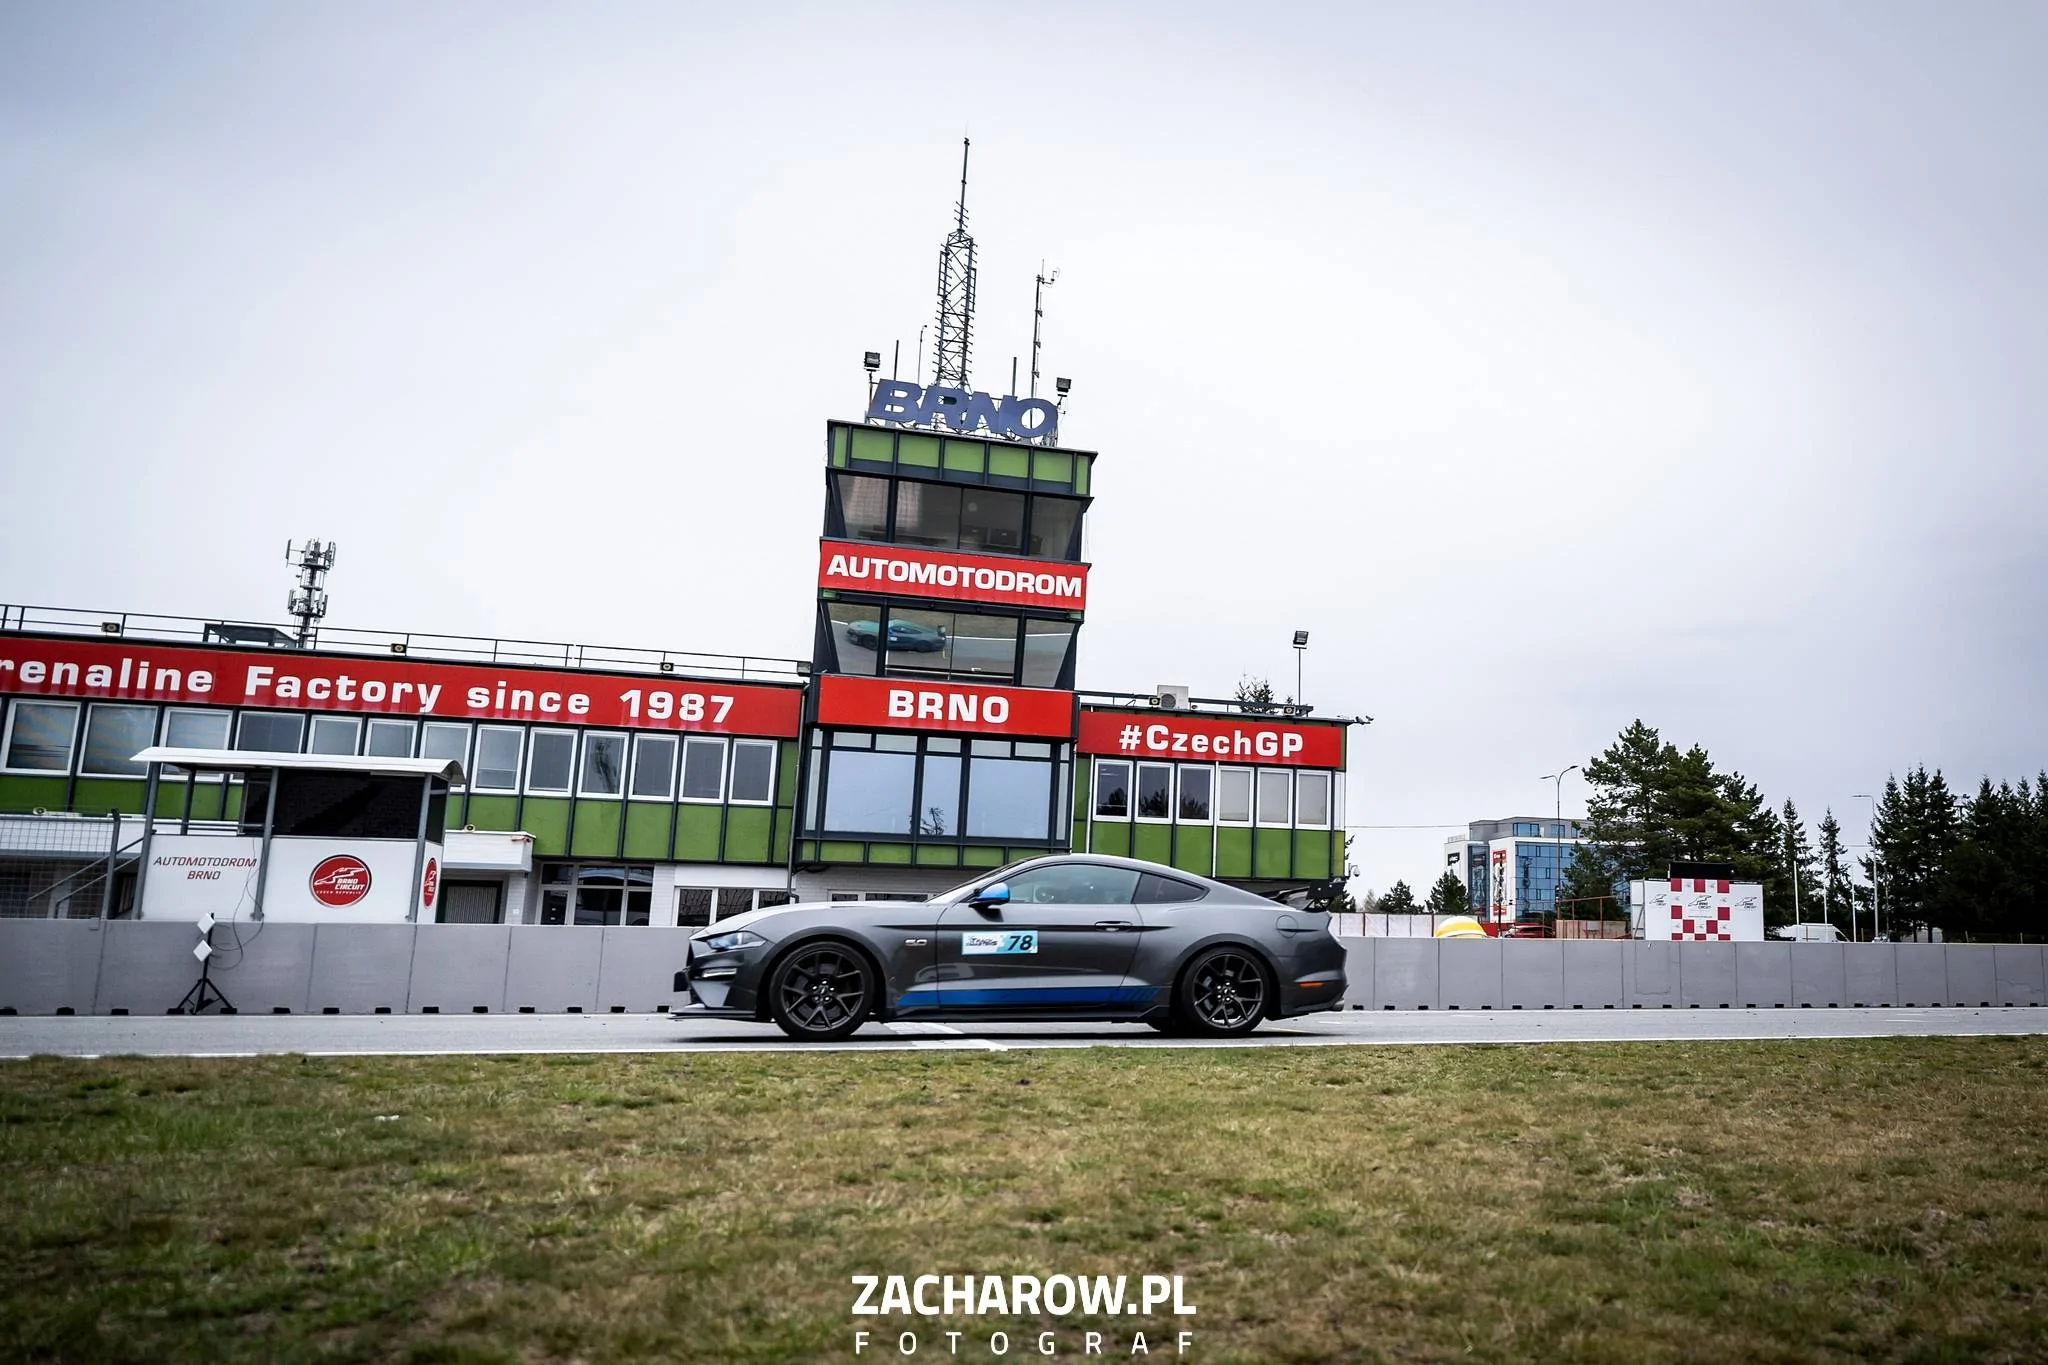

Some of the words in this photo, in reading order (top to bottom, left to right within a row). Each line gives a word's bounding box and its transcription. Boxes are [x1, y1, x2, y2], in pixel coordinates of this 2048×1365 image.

[867, 378, 1059, 438] BRNO
[826, 554, 1082, 598] AUTOMOTODROM
[245, 665, 443, 713] Factory
[466, 680, 591, 715] since
[619, 689, 735, 724] 1987
[888, 688, 1010, 725] BRNO
[1119, 723, 1304, 758] #CzechGP
[153, 856, 258, 868] AUTOMOTODROM
[187, 870, 221, 880] BRNO
[1008, 934, 1033, 951] 78
